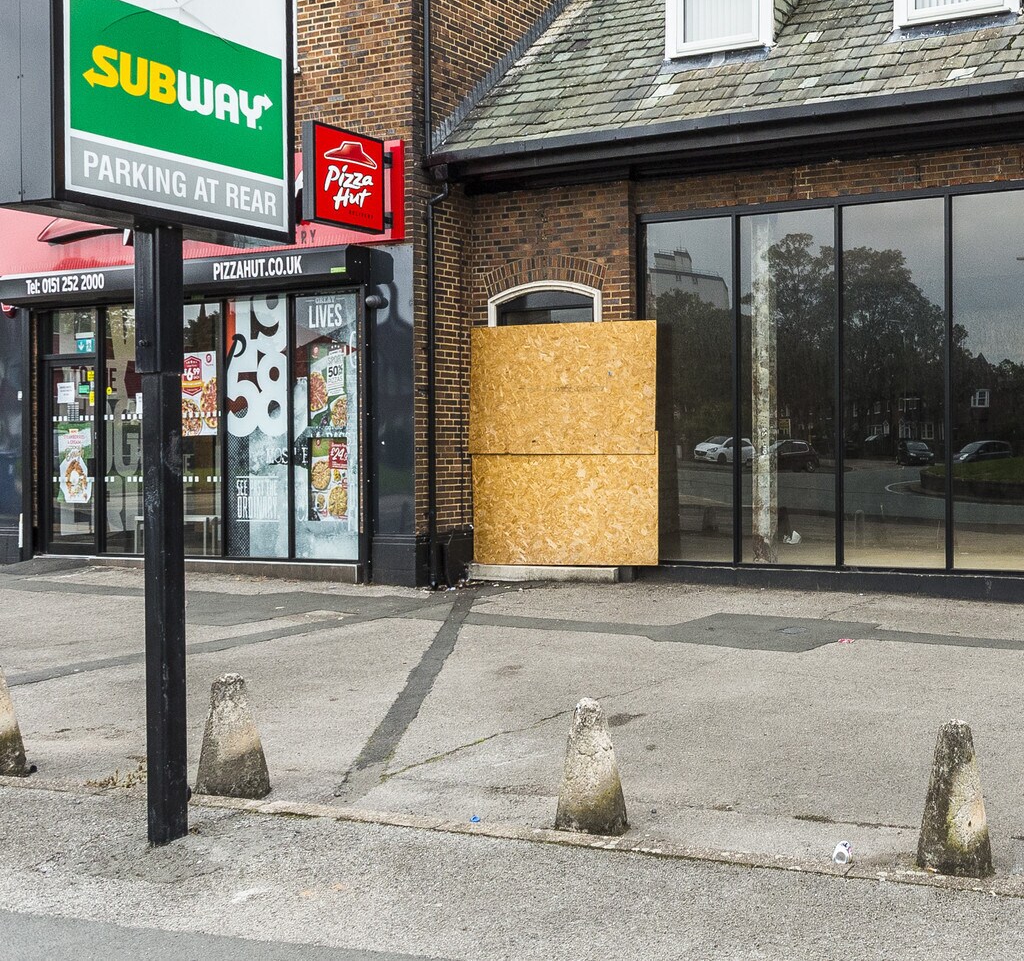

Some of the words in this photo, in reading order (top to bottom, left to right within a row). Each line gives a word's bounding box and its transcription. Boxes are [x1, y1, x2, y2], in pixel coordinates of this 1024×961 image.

[82, 44, 273, 130] SUBWAY
[83, 150, 186, 198] PARKING
[194, 176, 219, 204] AT
[226, 182, 276, 217] REAR
[324, 164, 374, 191] Pizza
[333, 187, 372, 210] Hut
[213, 255, 302, 280] PIZZAHUT.CO.UK
[26, 279, 40, 295] Tel:
[42, 277, 60, 294] 0151
[61, 275, 79, 292] 252
[81, 273, 104, 291] 2000
[309, 303, 342, 328] LIVES
